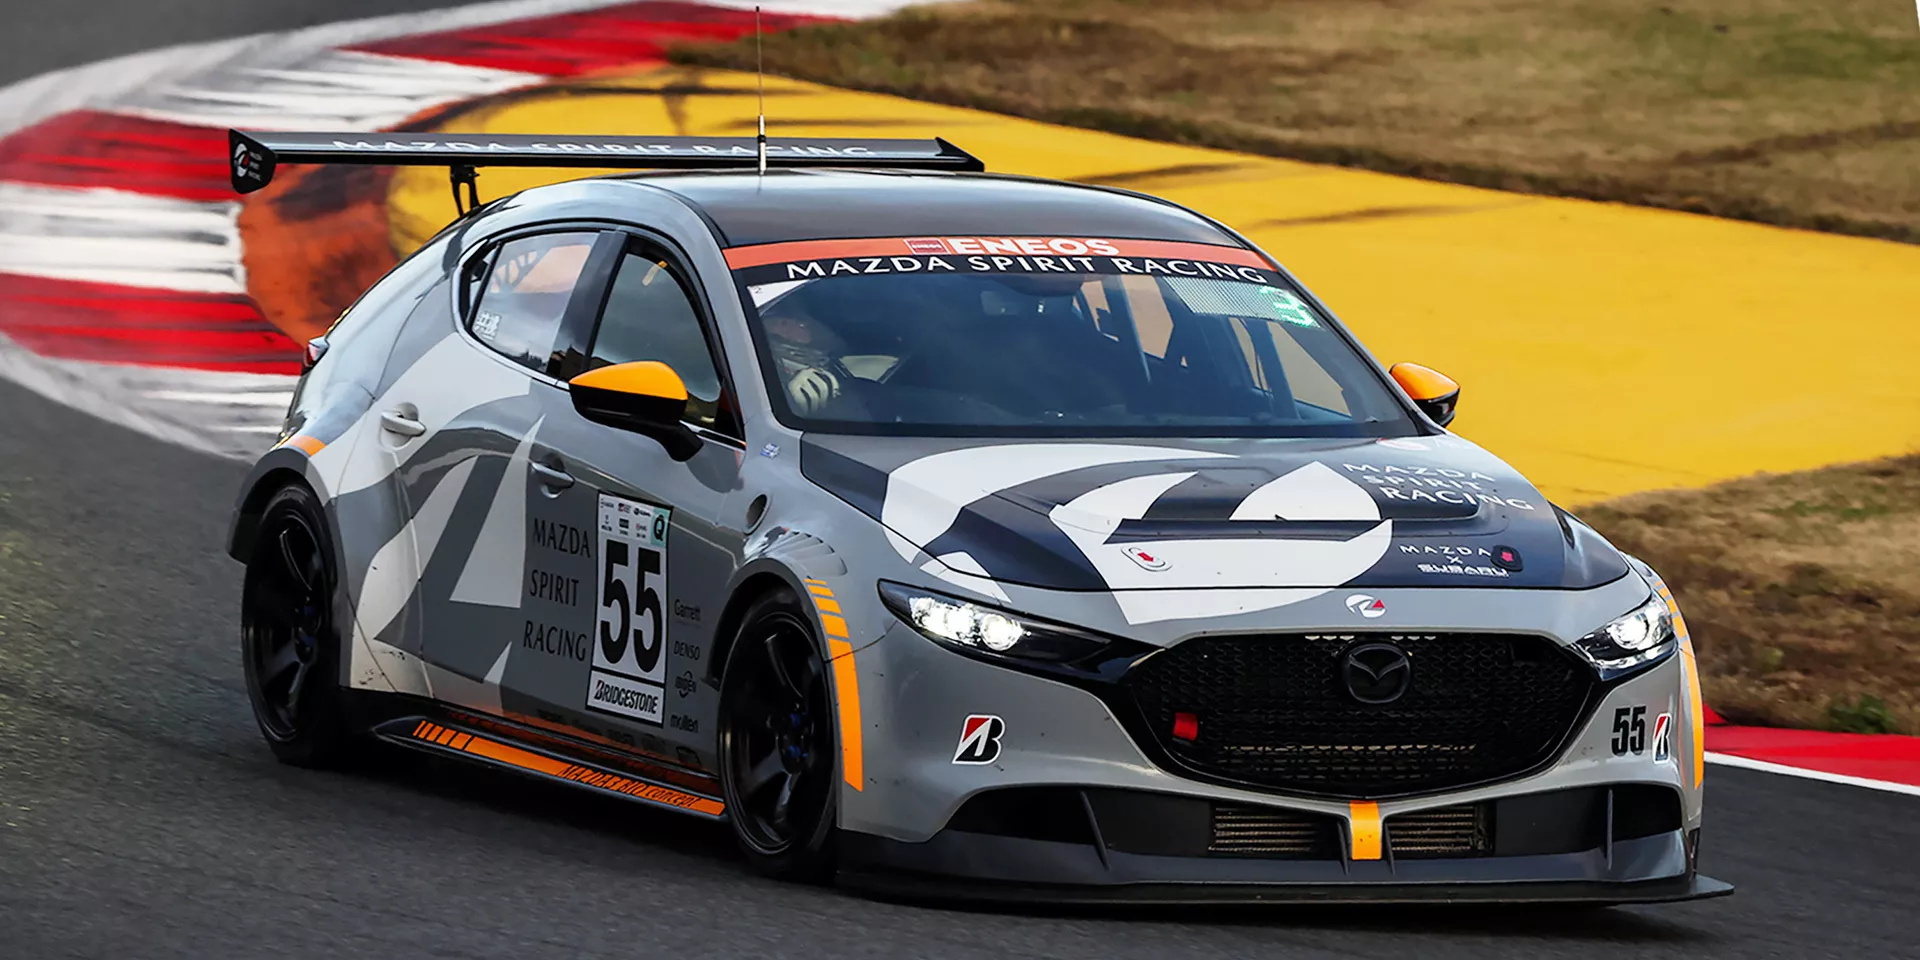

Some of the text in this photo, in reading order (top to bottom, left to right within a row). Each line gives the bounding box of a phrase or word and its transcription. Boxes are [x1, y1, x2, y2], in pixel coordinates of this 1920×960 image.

[333, 140, 876, 156] MAZDA SPIRIT RACING
[948, 238, 1120, 255] ENEOS
[786, 255, 1268, 284] MAZDA SPIRIT RACING
[1342, 462, 1496, 483] MAZDA
[1362, 474, 1482, 491] SPIRIT
[1379, 486, 1535, 511] RACING
[534, 518, 591, 558] MAZDA
[653, 514, 665, 542] Q
[1400, 544, 1492, 557] MAZDA
[529, 569, 579, 607] SPIRIT
[600, 538, 663, 673] 55
[523, 620, 588, 662] RACING
[672, 640, 700, 661] DENSO
[594, 679, 659, 715] BRIDGESTONE
[1611, 705, 1646, 756] 55
